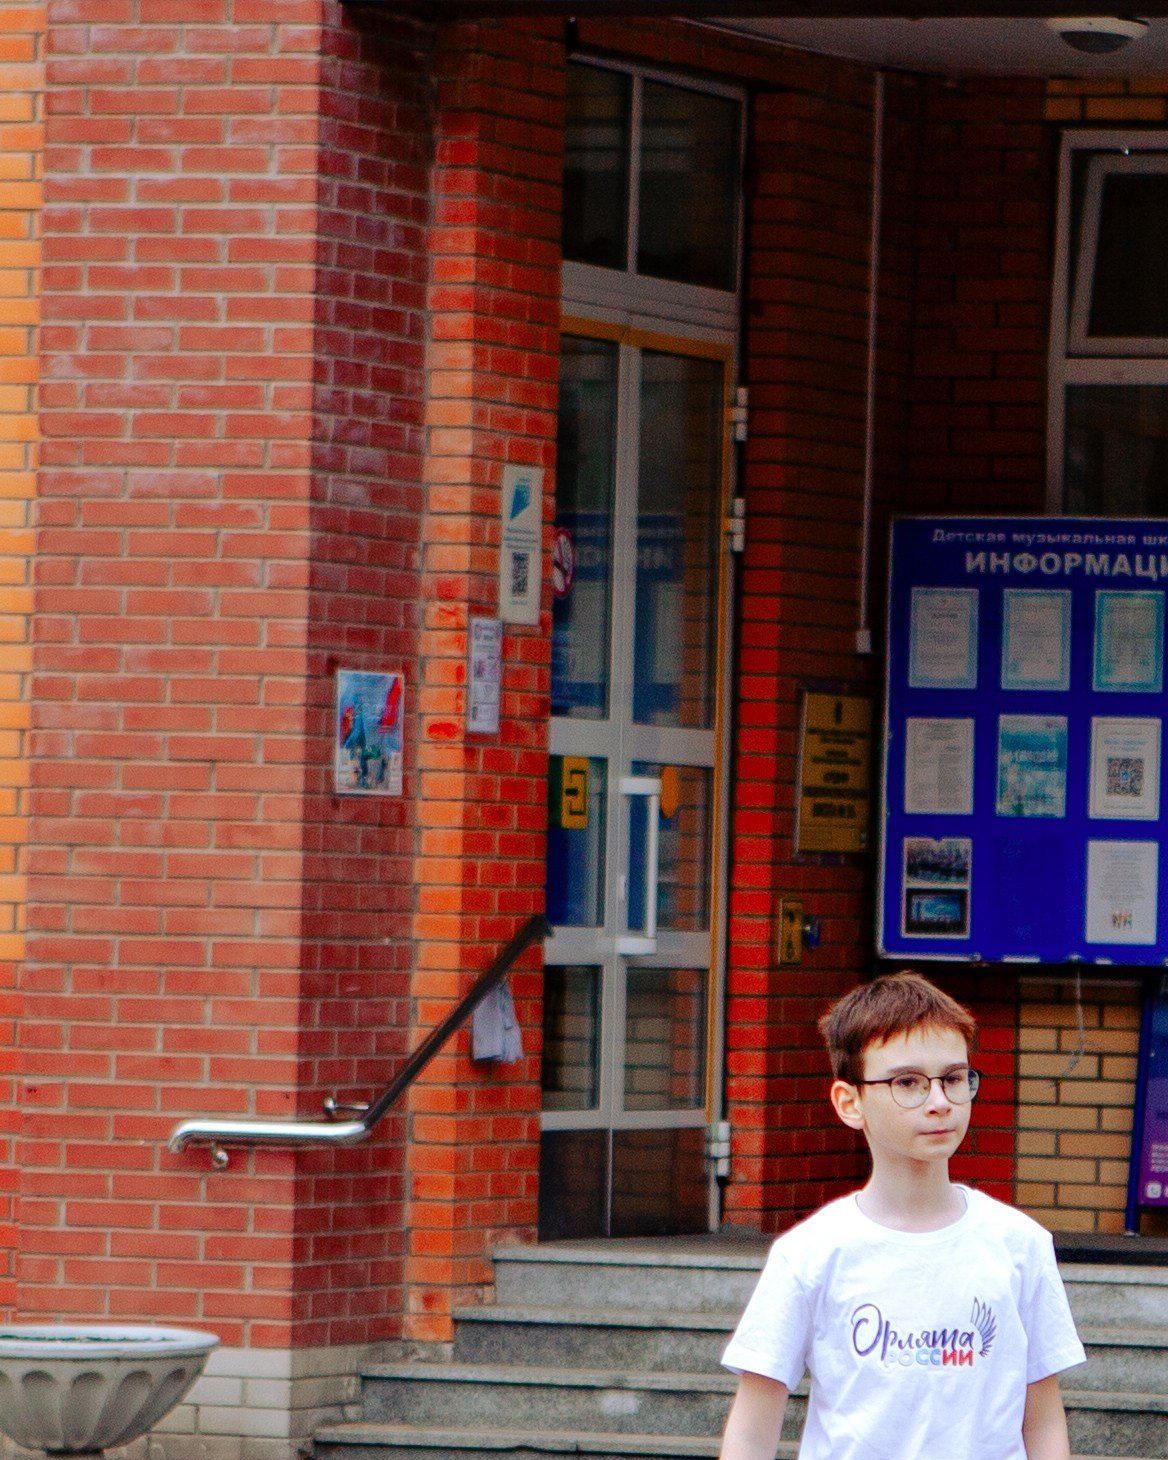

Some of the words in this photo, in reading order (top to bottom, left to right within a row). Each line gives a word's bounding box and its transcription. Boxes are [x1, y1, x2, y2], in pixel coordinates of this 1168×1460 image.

[932, 528, 1006, 544] Детская
[1012, 532, 1136, 547] музыкальная
[850, 1303, 975, 1361] Орлята
[884, 1348, 974, 1368] РОССИИ
